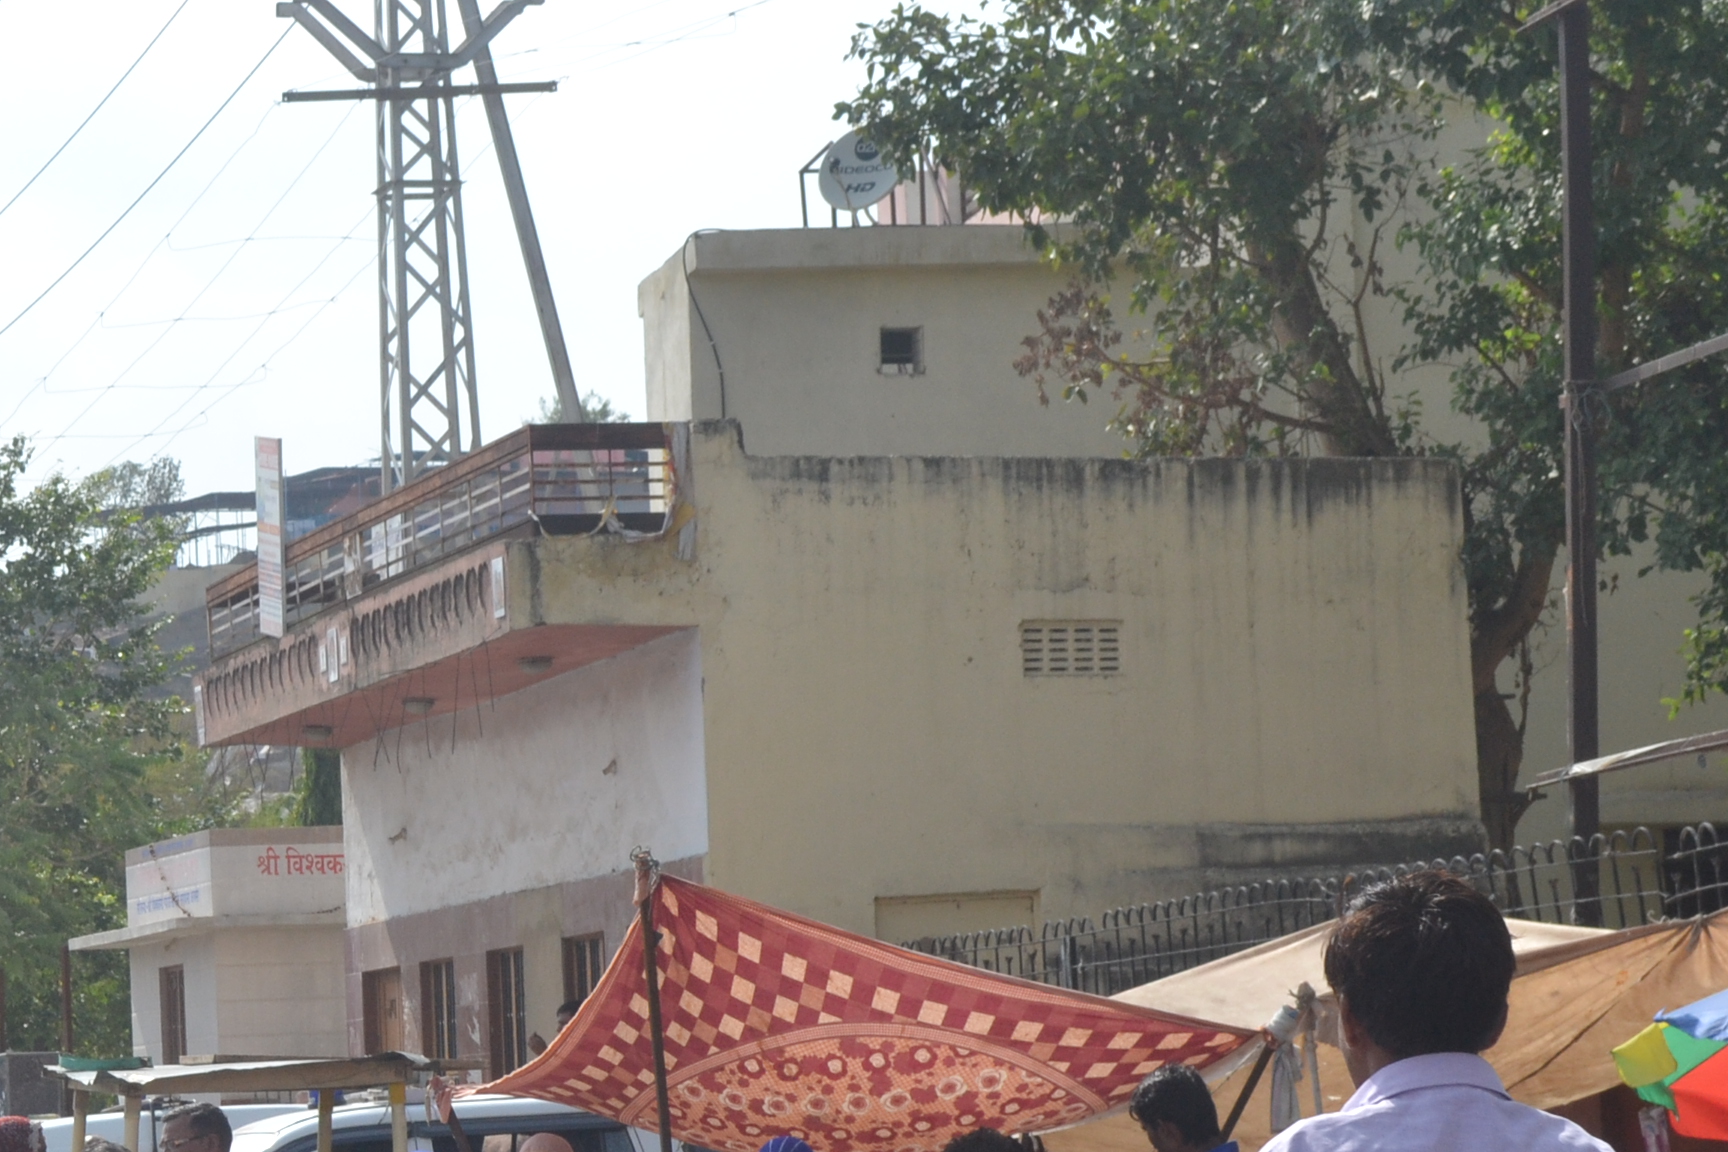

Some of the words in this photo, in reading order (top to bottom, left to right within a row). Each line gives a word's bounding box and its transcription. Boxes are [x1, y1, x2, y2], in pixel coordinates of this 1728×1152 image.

[846, 182, 876, 193] HD
[257, 846, 280, 876] श्री
[285, 846, 345, 876] विश्वक
